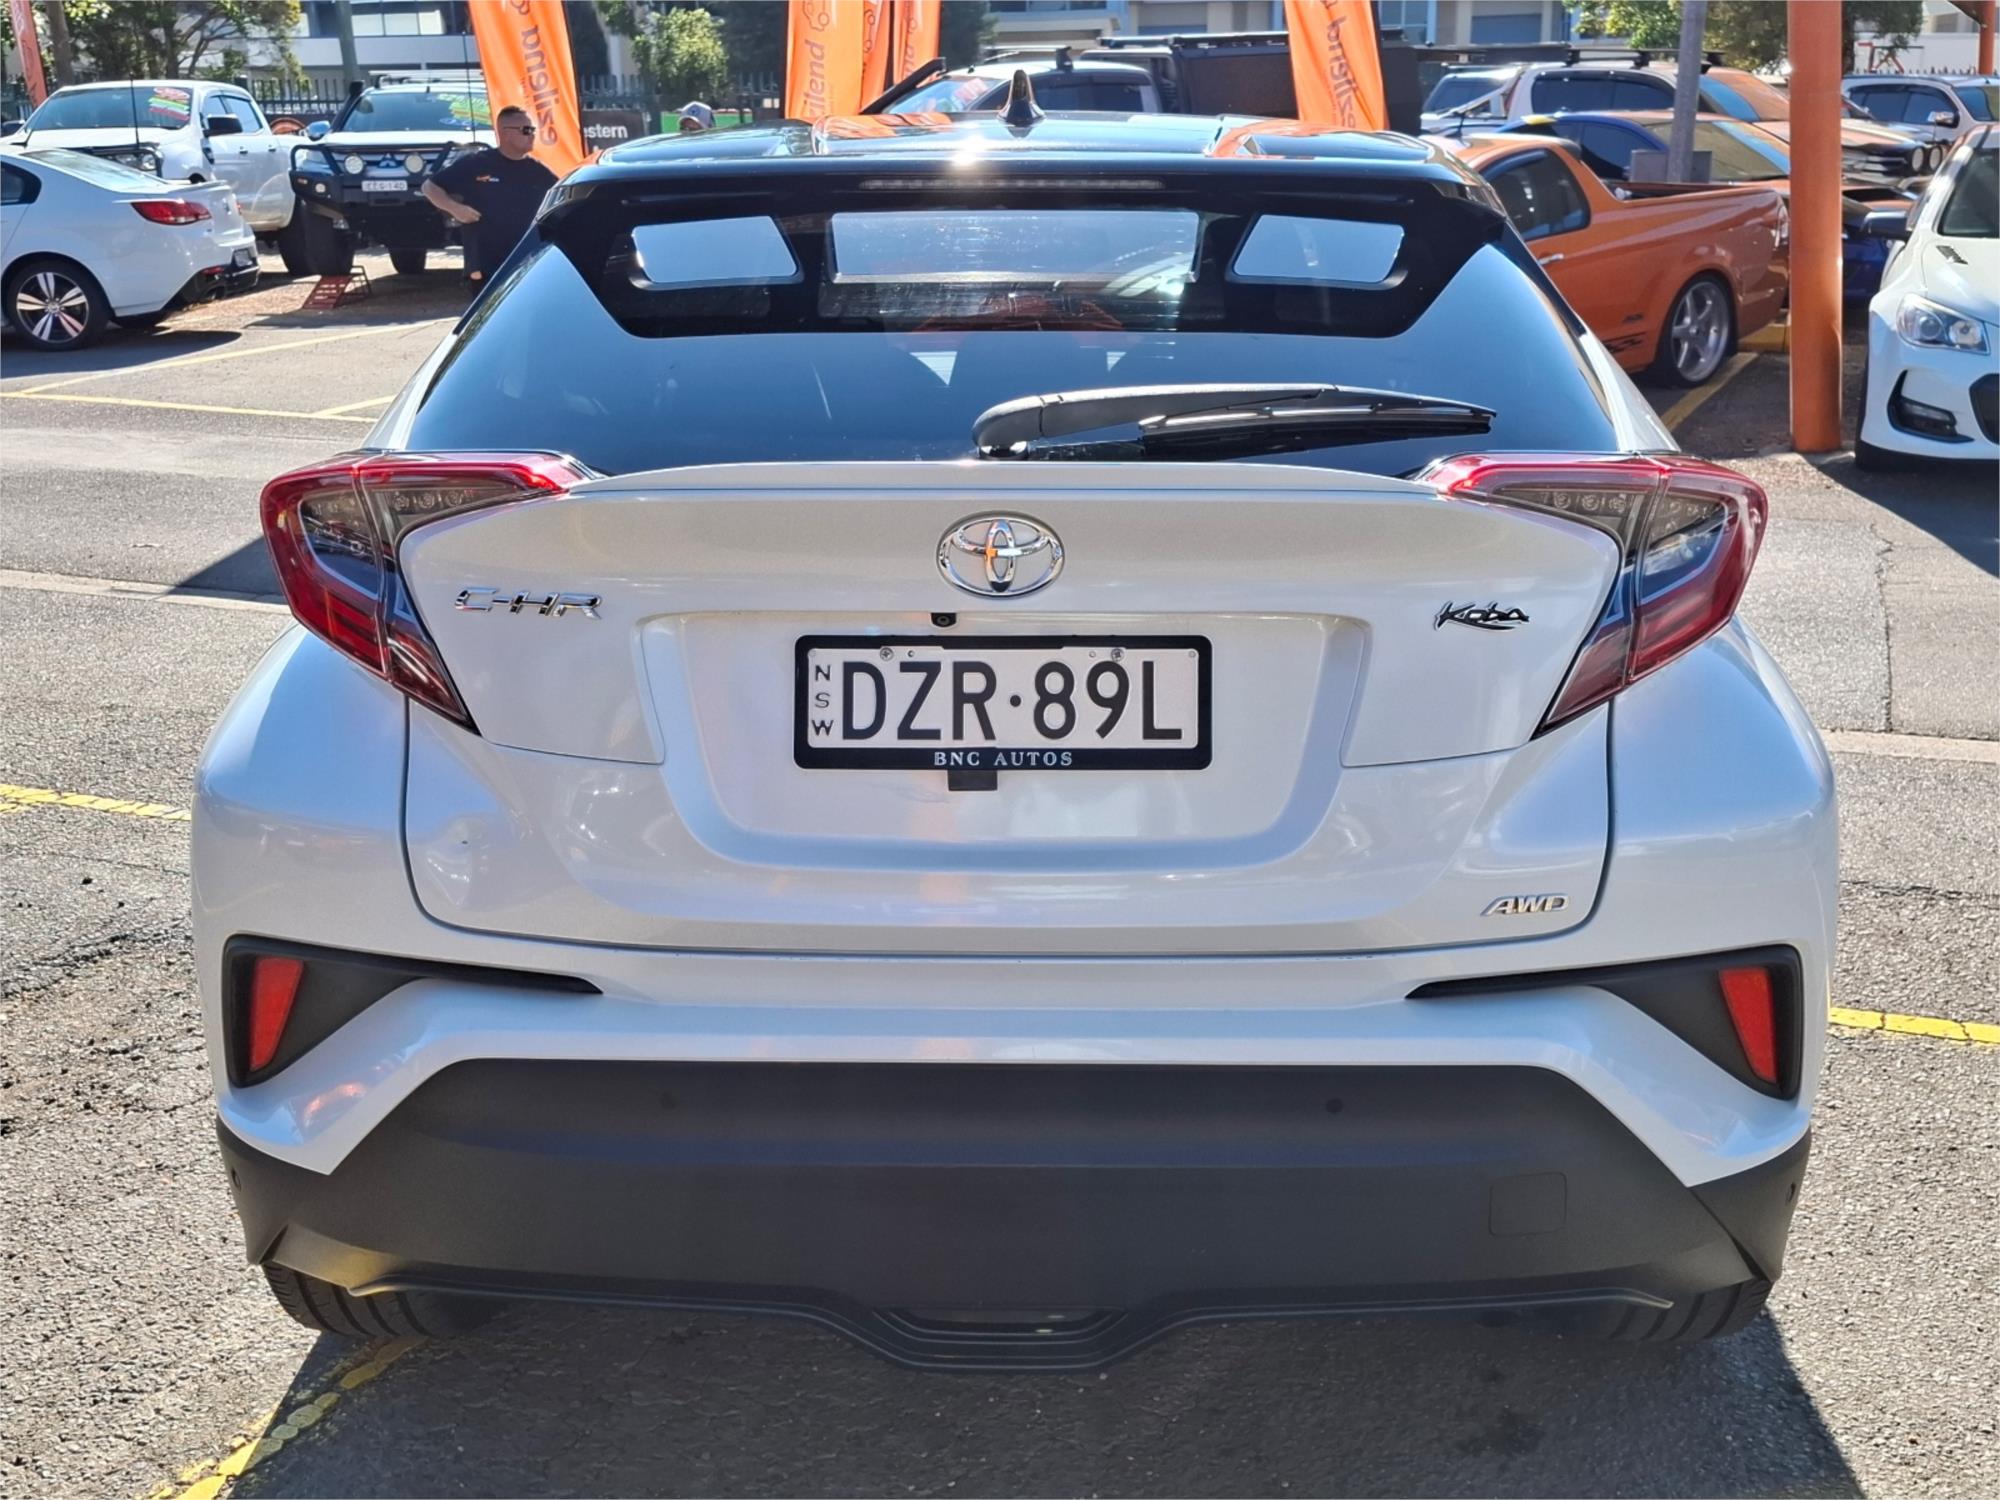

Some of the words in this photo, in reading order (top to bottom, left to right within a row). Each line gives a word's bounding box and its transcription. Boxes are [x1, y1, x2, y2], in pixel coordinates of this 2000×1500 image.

[455, 587, 602, 619] C-HR
[1435, 601, 1530, 630] Koba
[994, 751, 1073, 766] AUTOS
[1480, 893, 1568, 916] AWD
